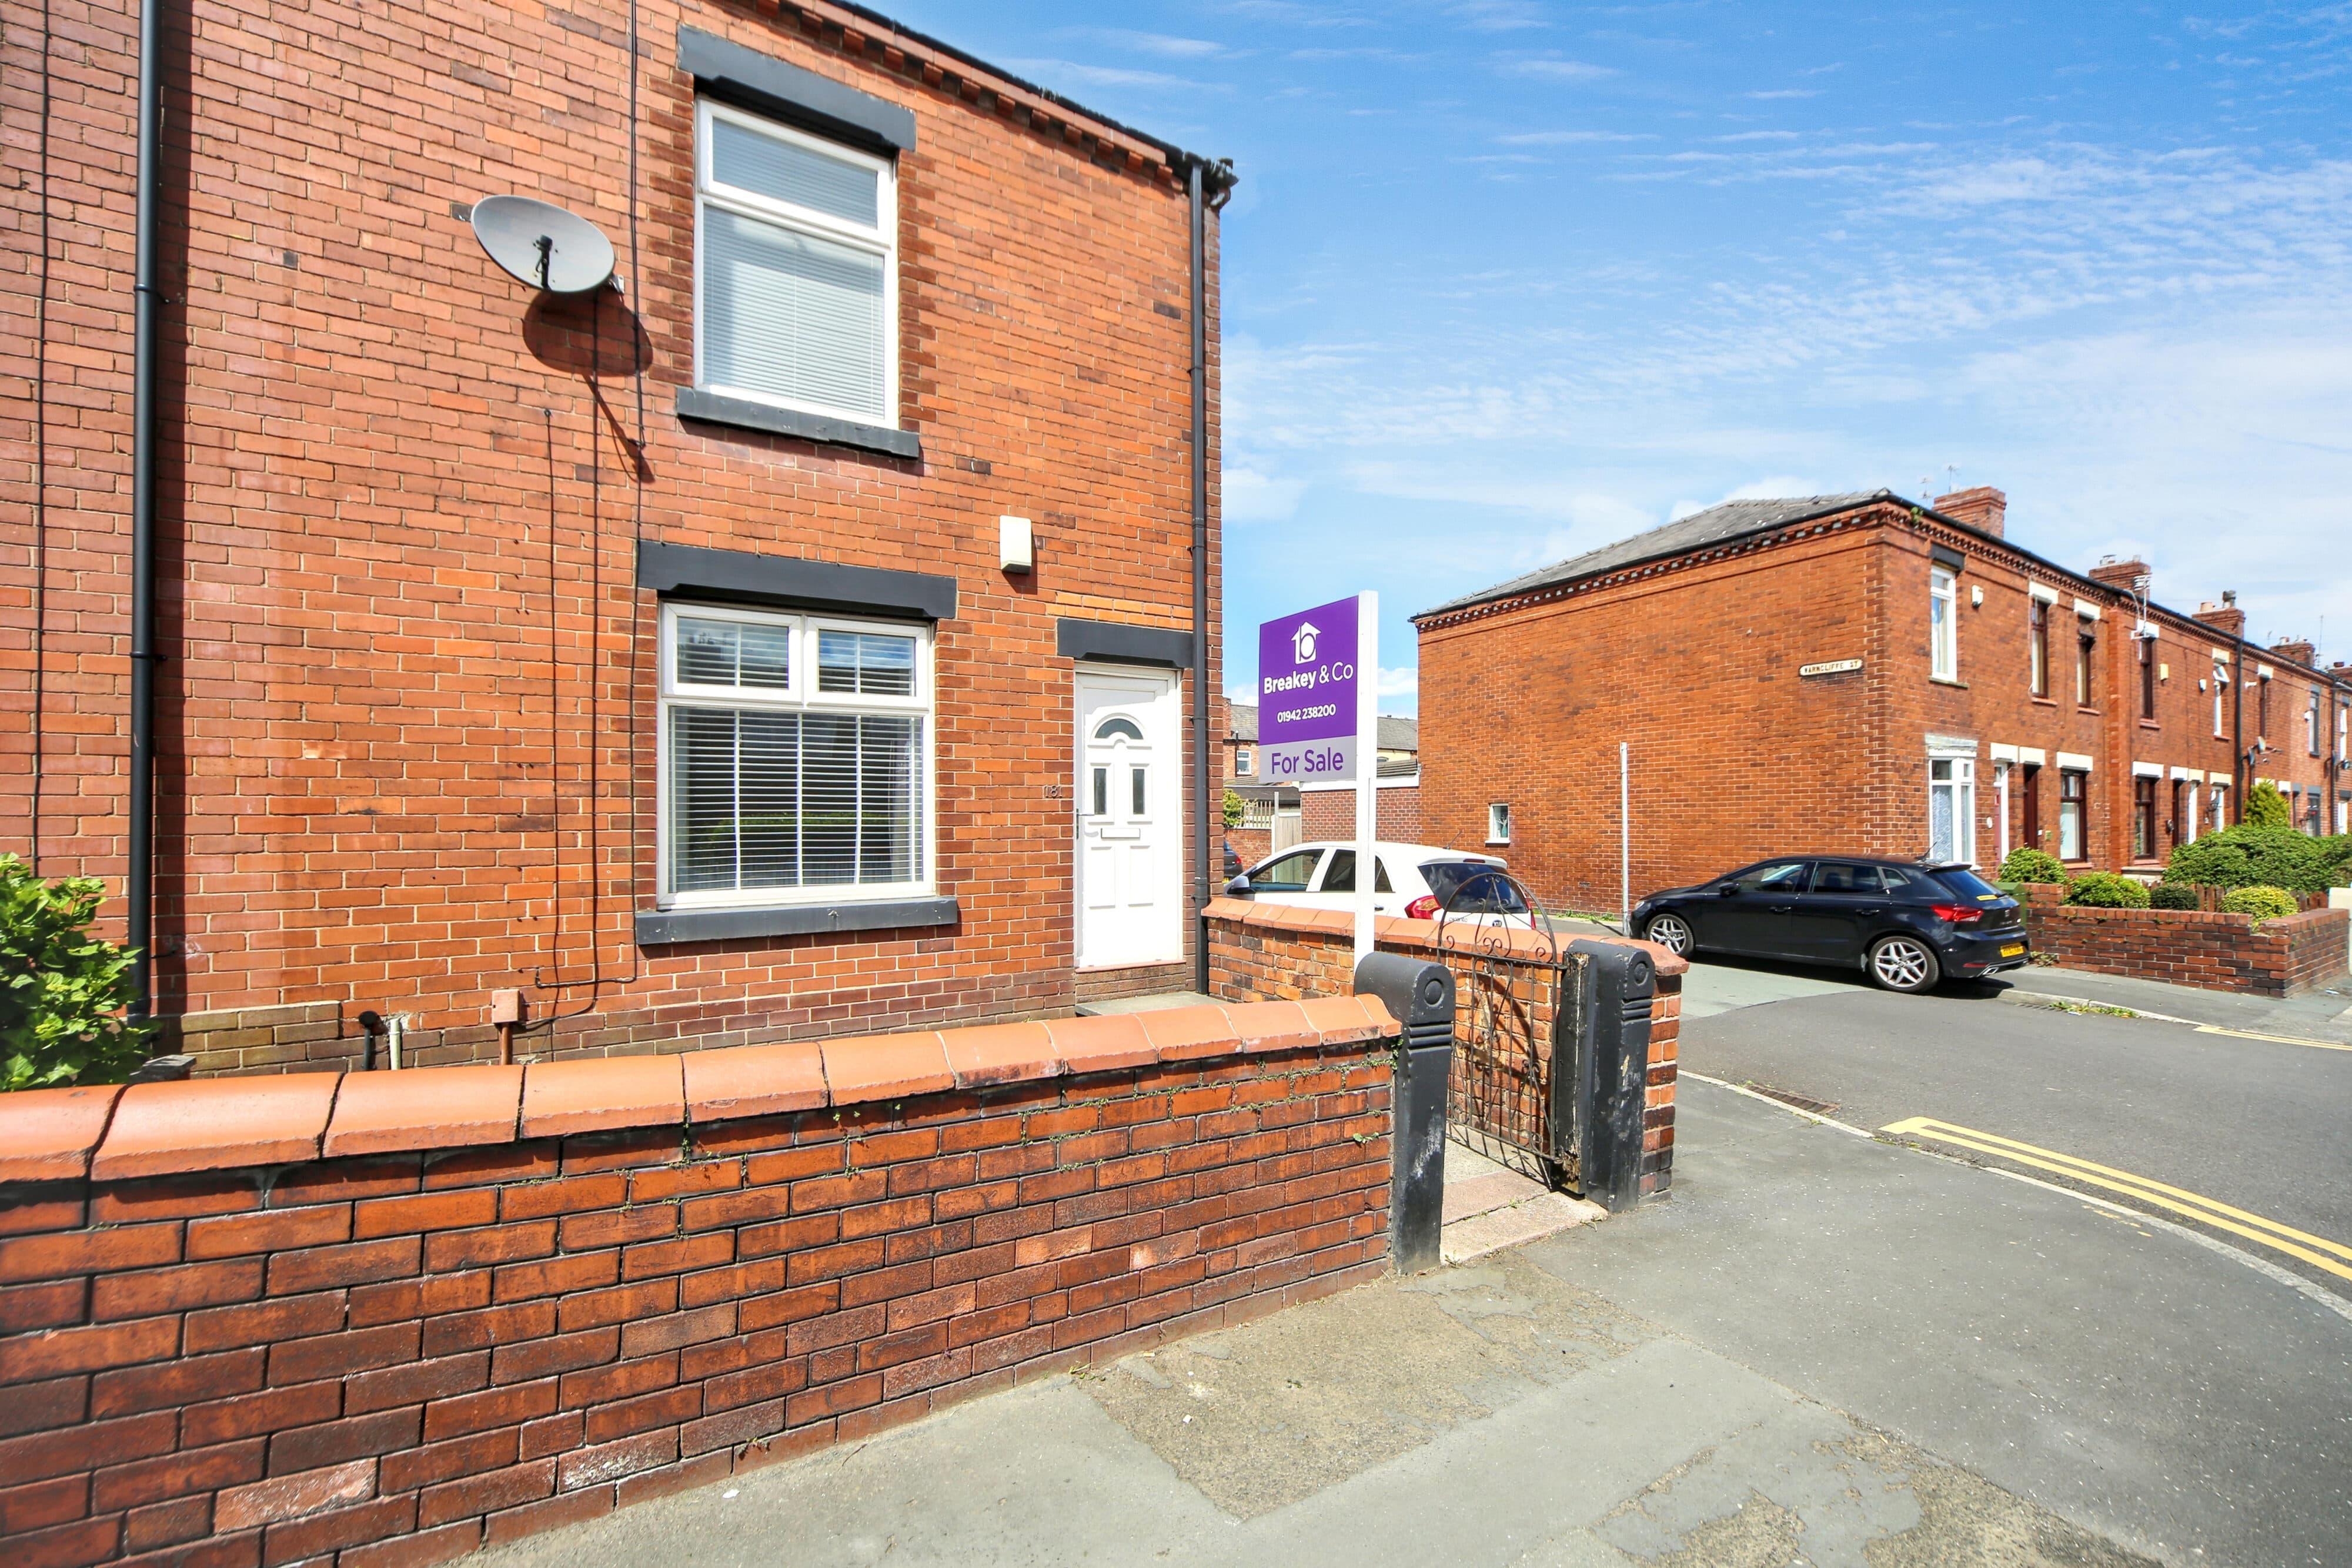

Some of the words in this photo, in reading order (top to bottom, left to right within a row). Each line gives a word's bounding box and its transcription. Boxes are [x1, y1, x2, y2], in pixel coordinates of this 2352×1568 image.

[1264, 670, 1317, 694] Breakey
[1319, 665, 1329, 684] &
[1332, 661, 1354, 681] Co
[1277, 709, 1301, 723] 01942
[1302, 704, 1337, 720] 238200
[1271, 753, 1299, 774] For
[1304, 747, 1344, 773] Sale
[1044, 785, 1063, 797] 181
